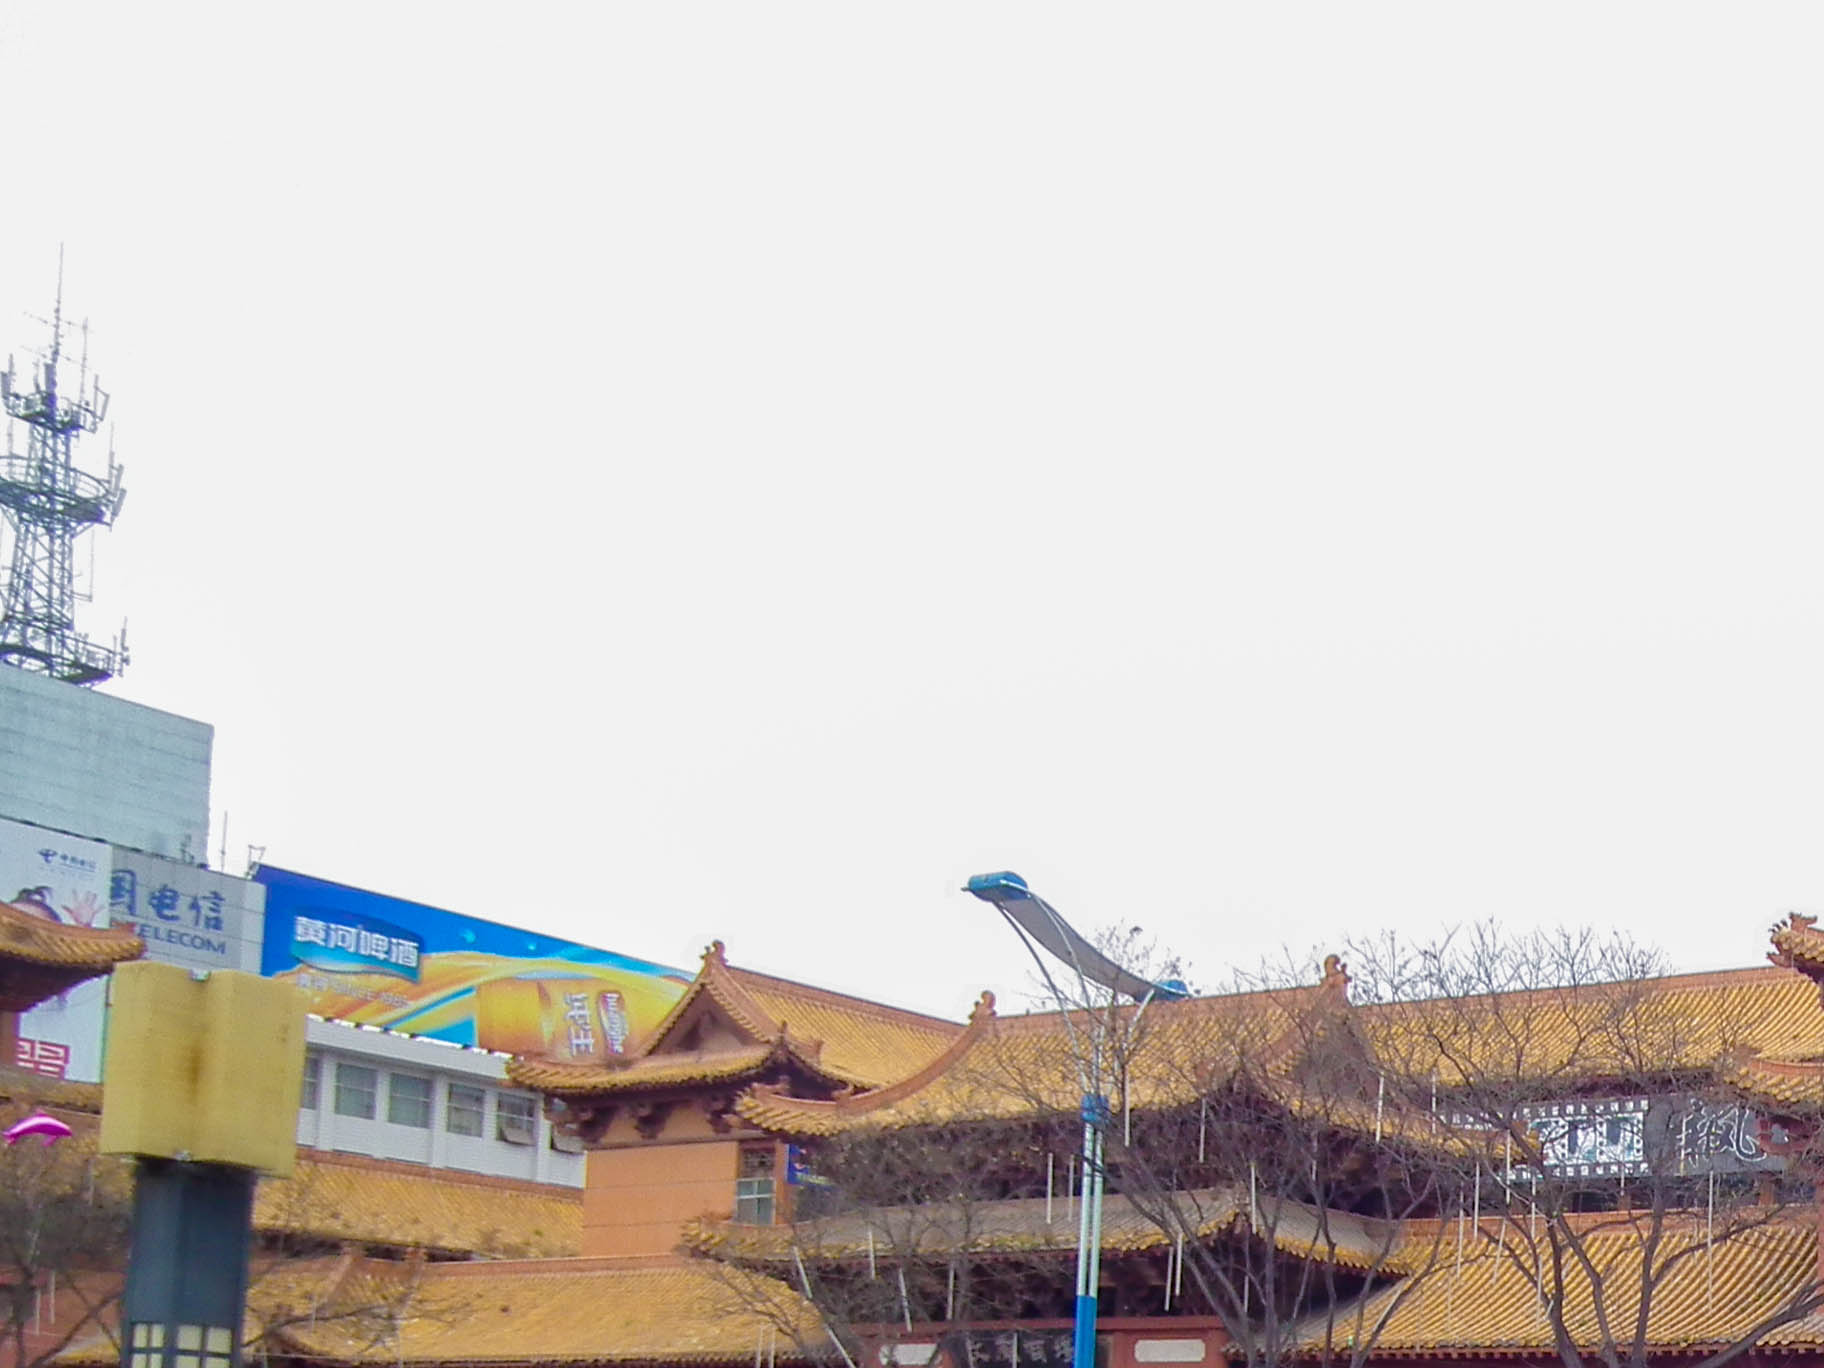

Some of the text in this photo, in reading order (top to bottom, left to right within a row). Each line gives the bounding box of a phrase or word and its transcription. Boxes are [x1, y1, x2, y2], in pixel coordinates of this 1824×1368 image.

[136, 923, 226, 955] ELECOM
[295, 915, 420, 968] 黄河啤酒
